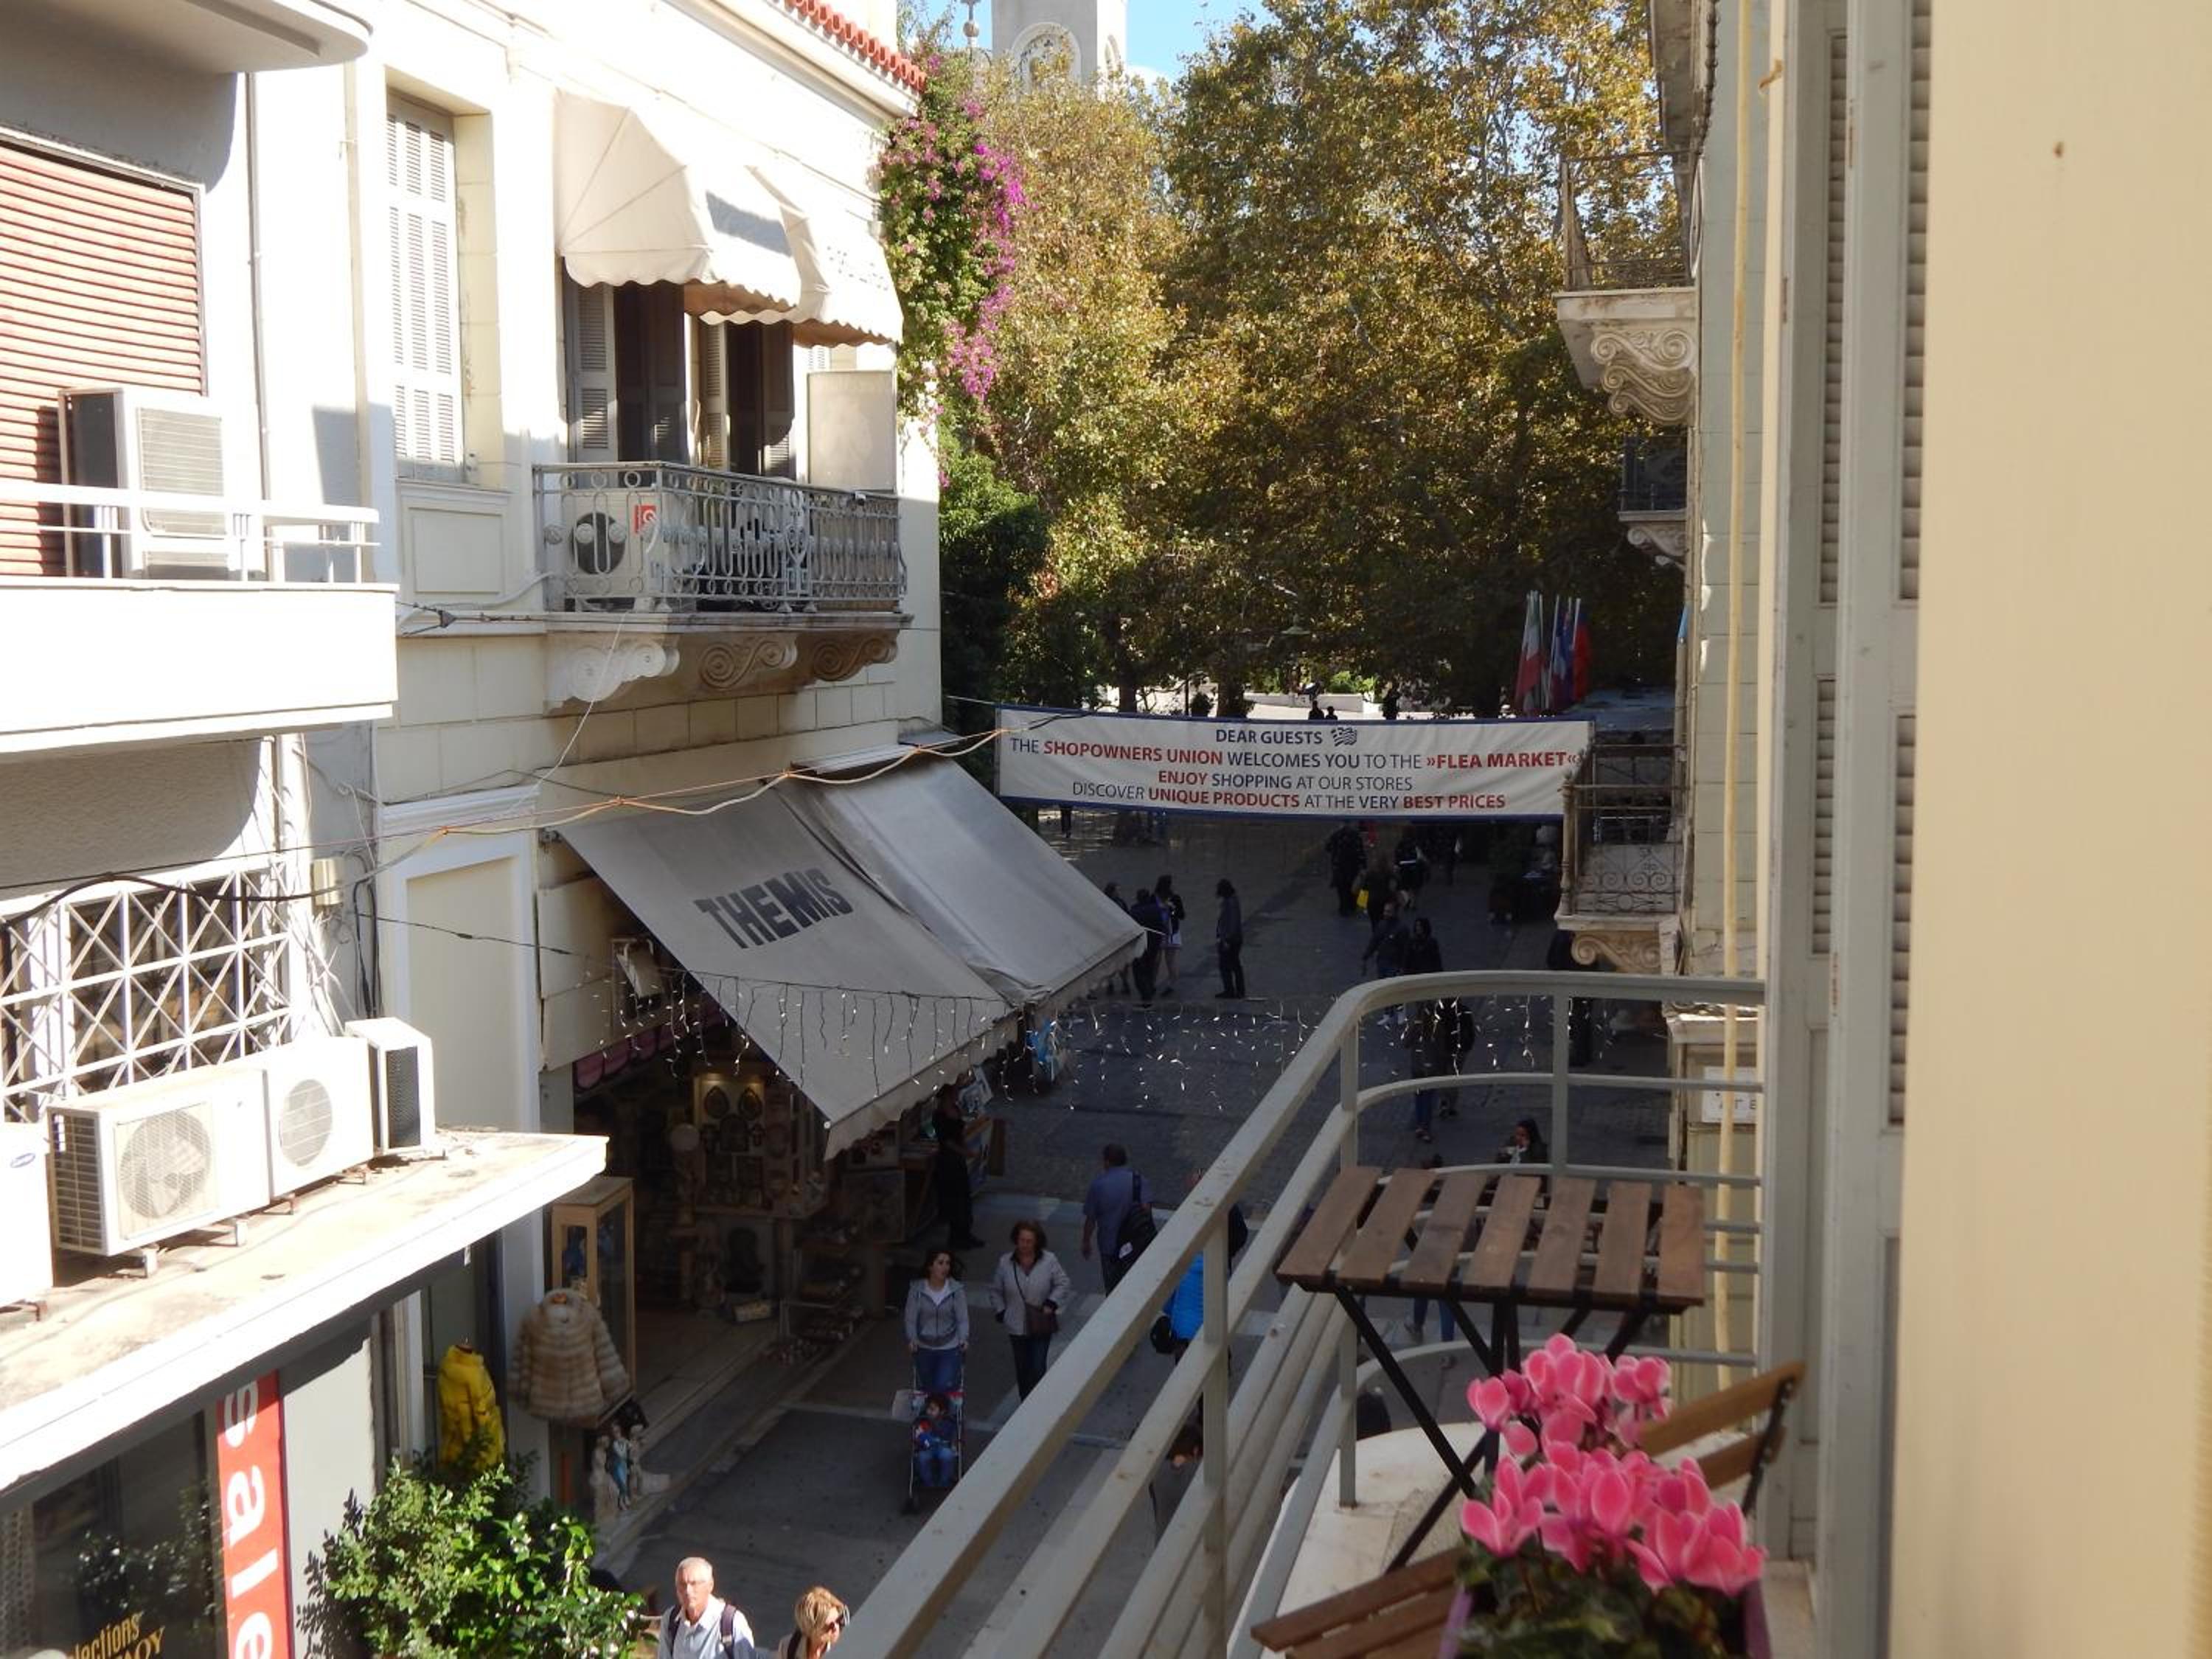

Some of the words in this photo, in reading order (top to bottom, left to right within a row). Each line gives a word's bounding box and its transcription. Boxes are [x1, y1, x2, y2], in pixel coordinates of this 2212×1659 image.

[1216, 728, 1256, 743] DEAR
[1261, 731, 1323, 745] GUESTS
[1011, 737, 1039, 754] THE
[1043, 740, 1162, 762] SHOPOWNERS
[1167, 749, 1223, 765] UNION
[1228, 751, 1321, 768] WELCOMES
[1325, 754, 1360, 769] YOU
[1365, 754, 1386, 769] TO
[1391, 754, 1422, 769] THE
[1073, 782, 1145, 799] DISCOVER
[1149, 787, 1209, 805] UNIQUE
[1213, 792, 1299, 807] PRODUCTS
[1304, 794, 1324, 808] AT
[1326, 795, 1354, 809] THE
[1359, 796, 1399, 810] VERY
[1403, 796, 1444, 809] BEST
[1449, 794, 1506, 809] PRICES
[1158, 771, 1208, 787] ENJOY
[1211, 773, 1292, 789] SHOPPING
[1296, 776, 1315, 789] AT
[1318, 776, 1352, 790] OUR
[1356, 776, 1413, 791] STORES
[692, 867, 854, 949] THEMIS
[224, 1380, 278, 1659] sale
[70, 1610, 145, 1659] lections
